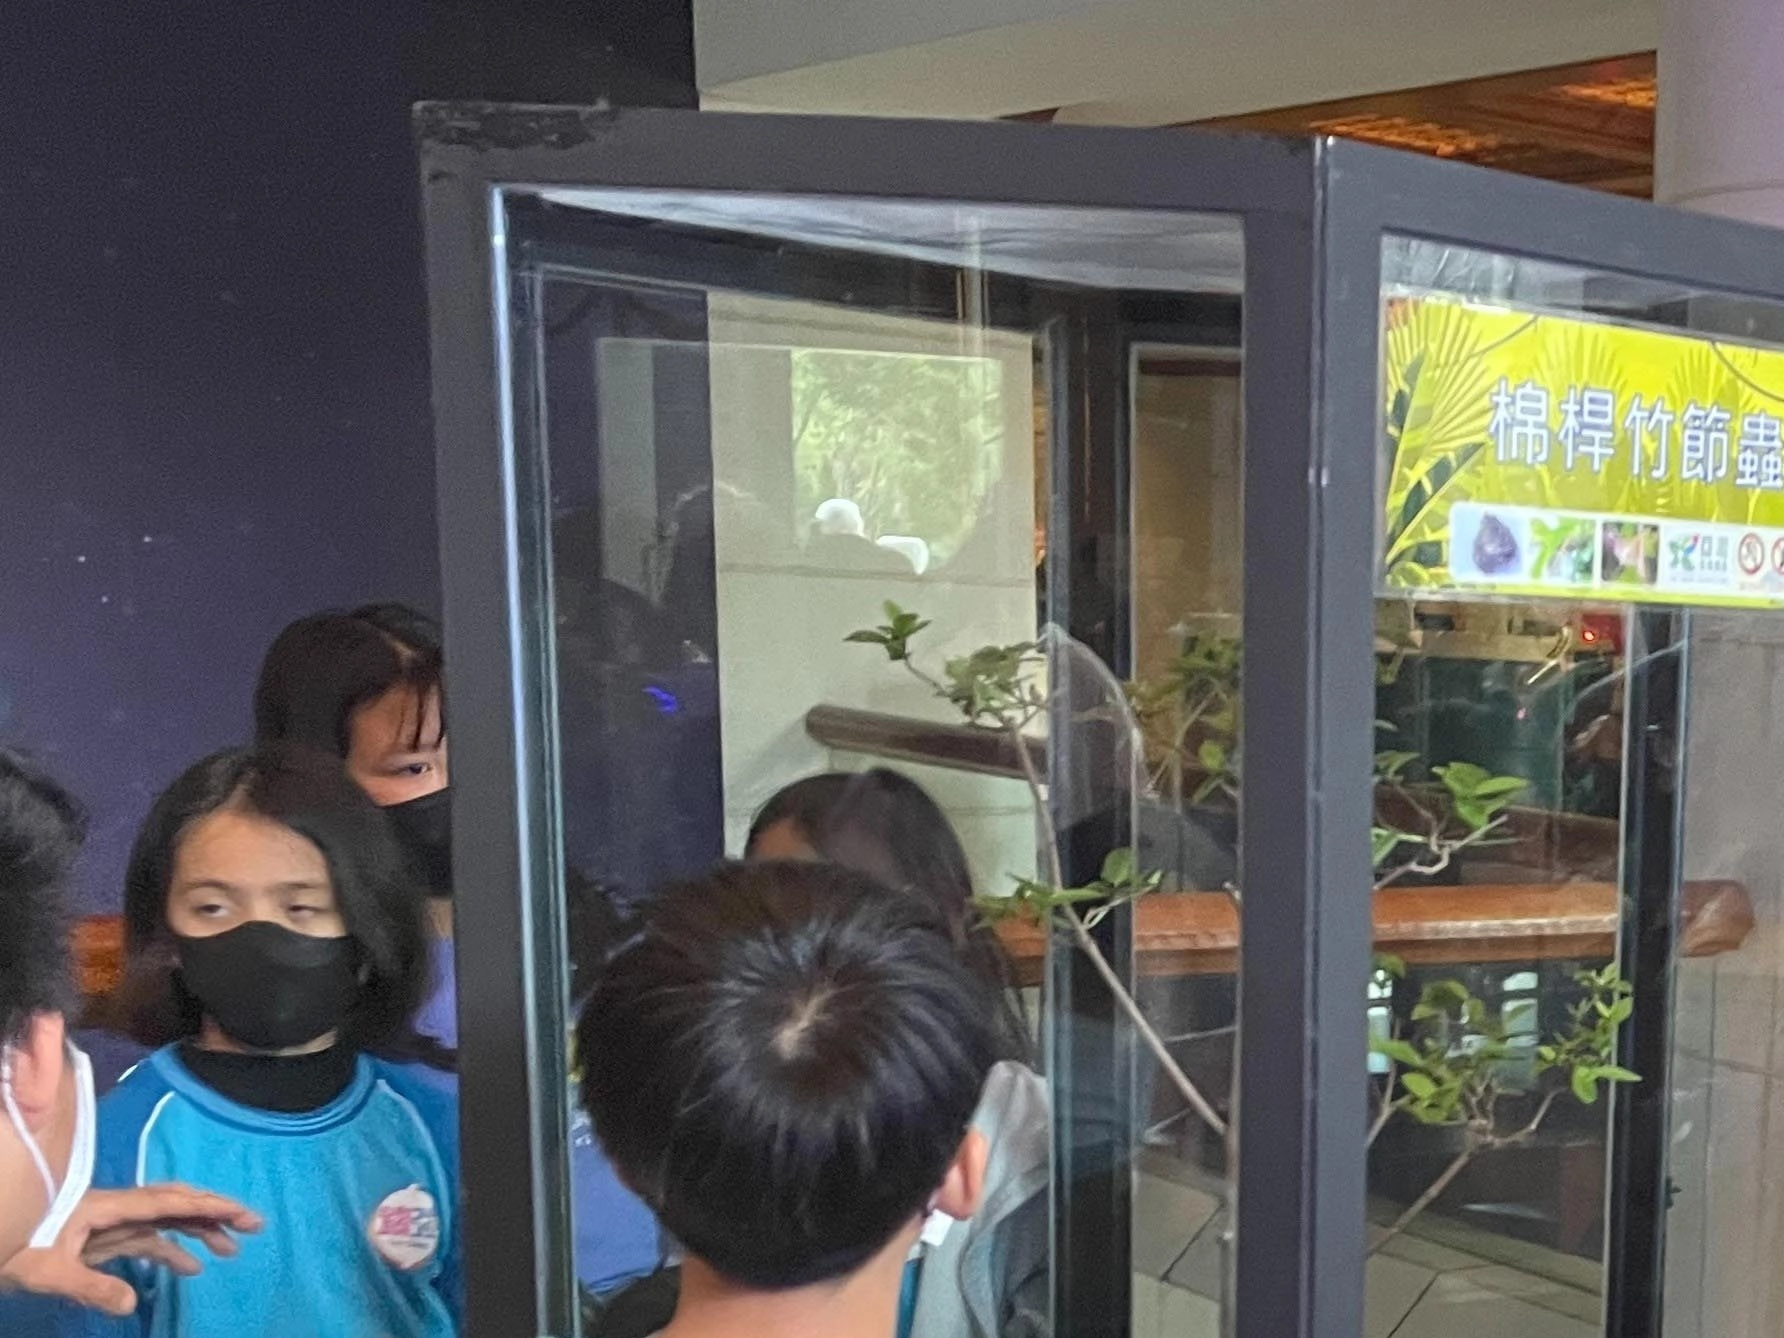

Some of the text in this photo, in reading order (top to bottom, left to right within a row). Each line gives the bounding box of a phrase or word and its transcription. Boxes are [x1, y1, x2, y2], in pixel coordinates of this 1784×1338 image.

[1489, 377, 1784, 490] 棉桿竹節蟲
